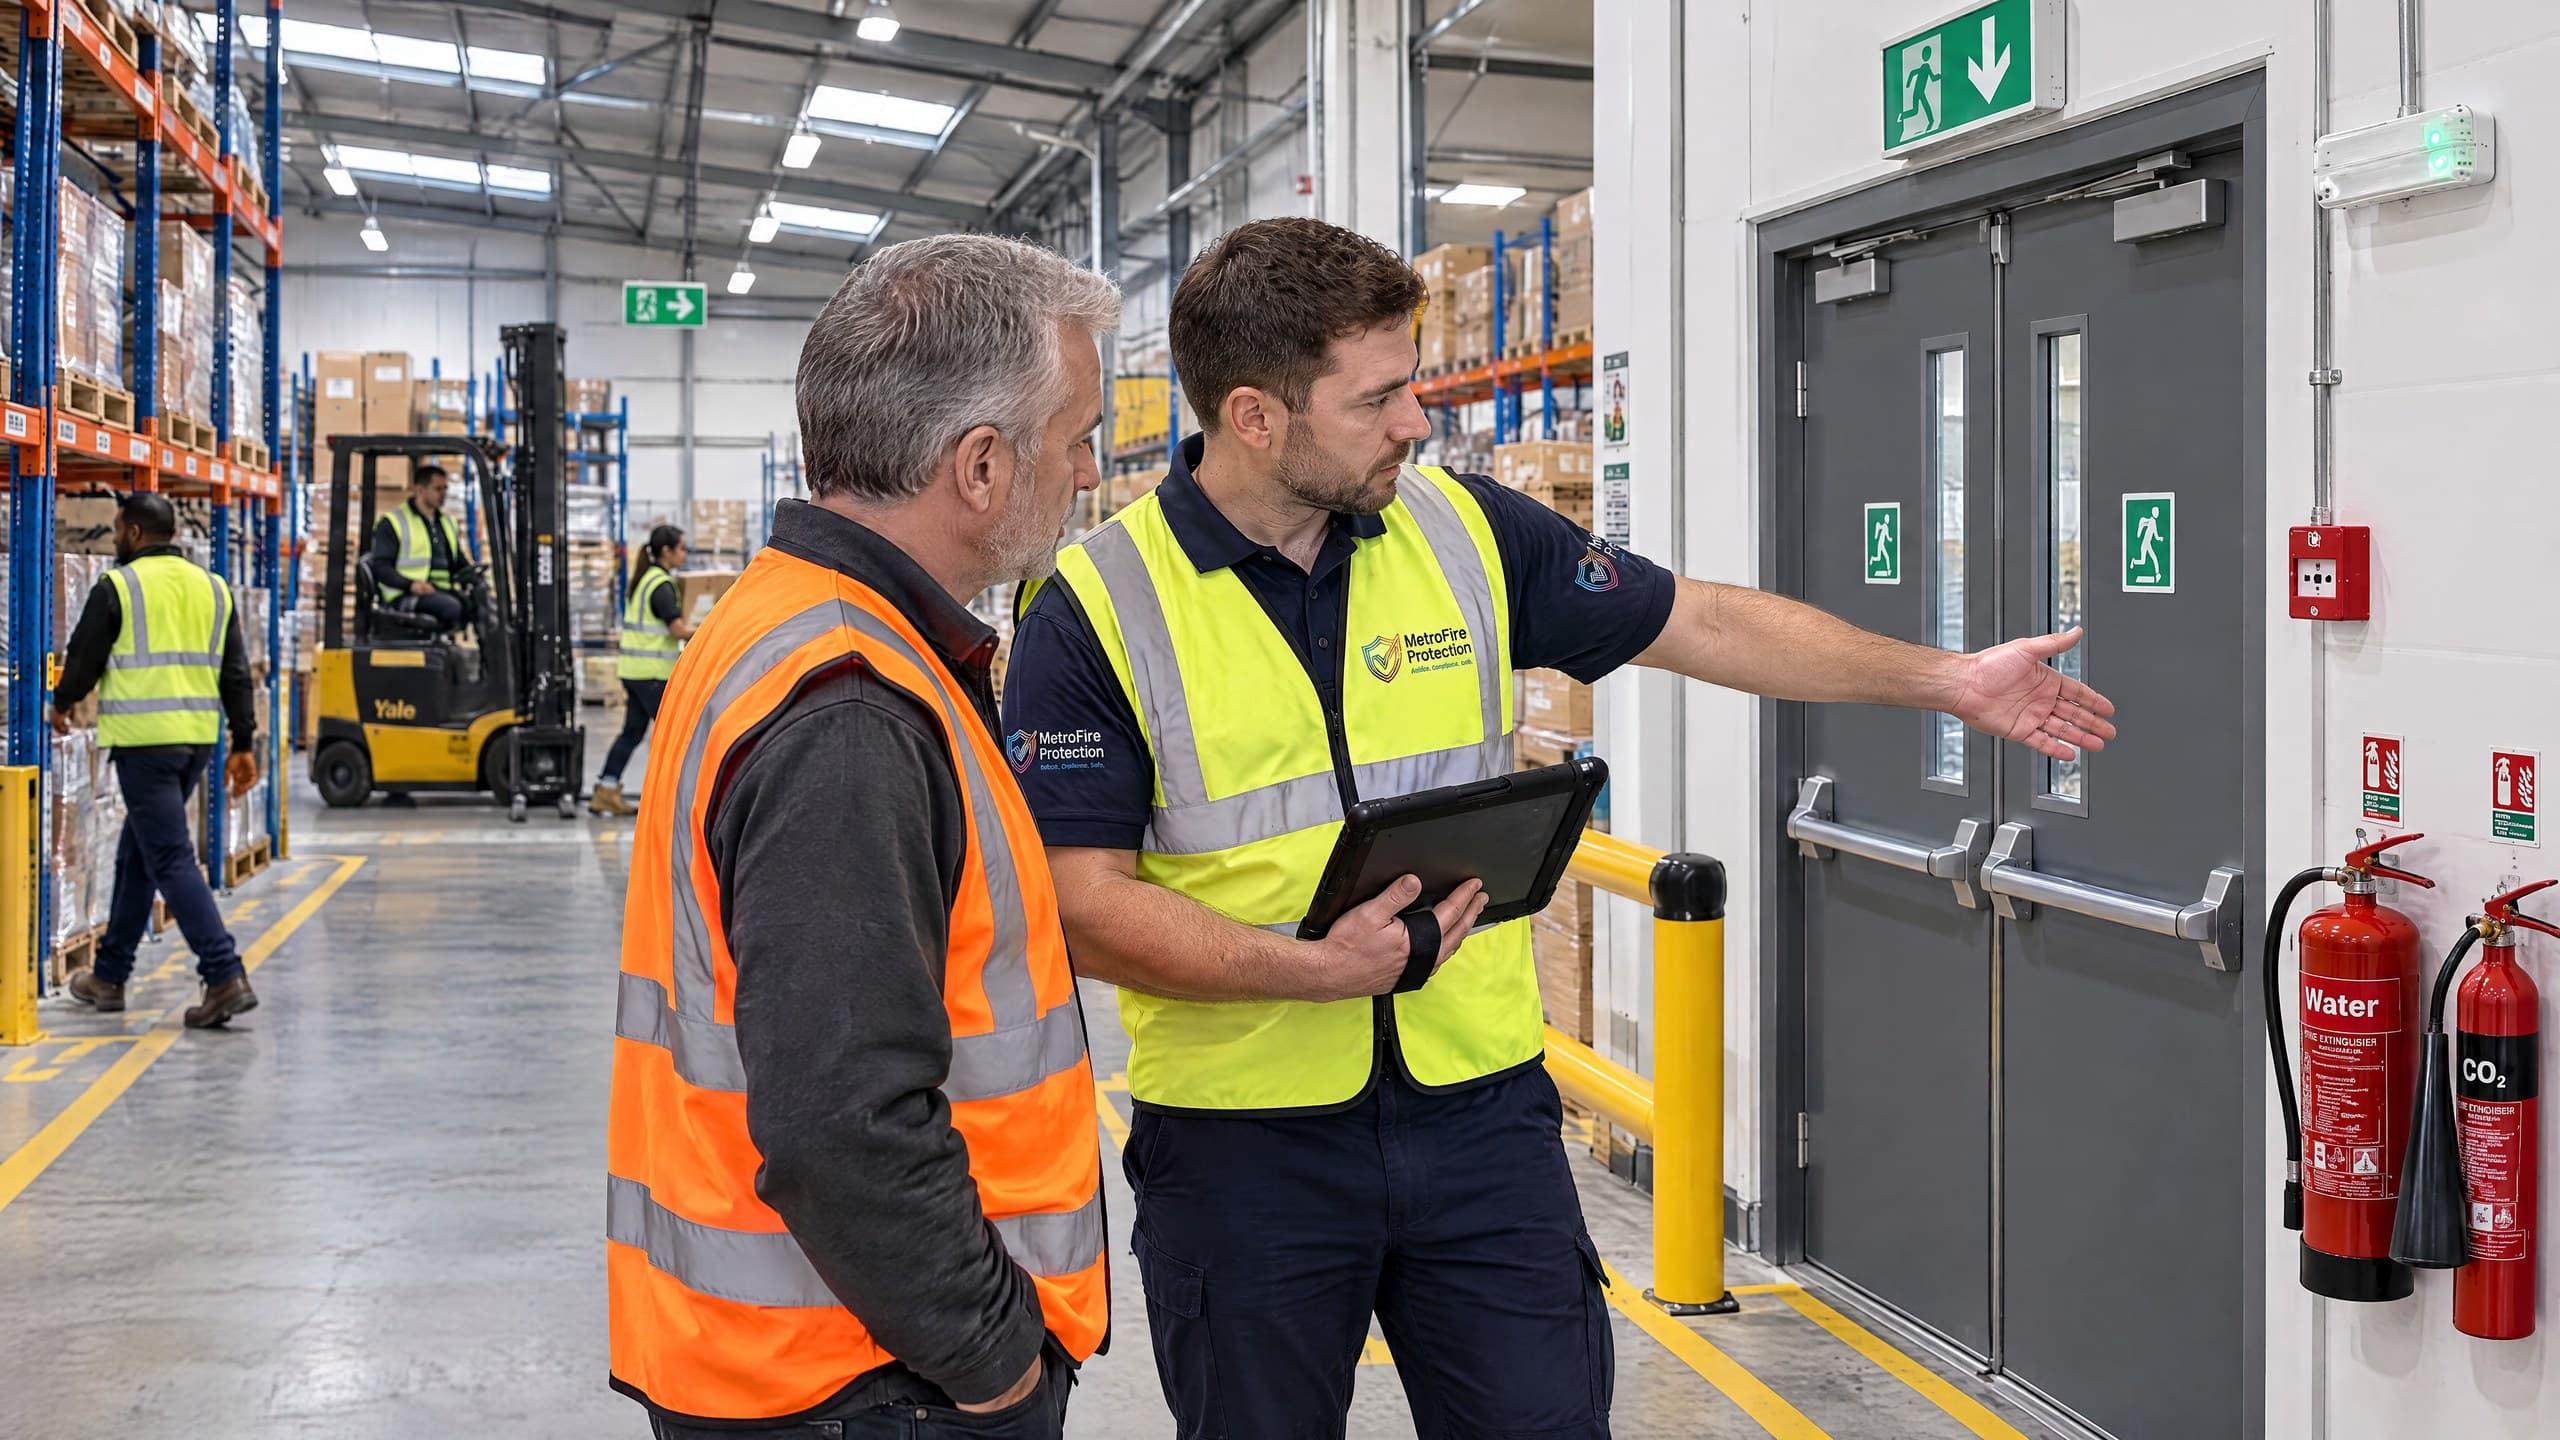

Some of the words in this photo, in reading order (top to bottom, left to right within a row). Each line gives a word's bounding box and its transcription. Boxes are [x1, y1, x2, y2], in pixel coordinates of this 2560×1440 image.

[1404, 628, 1467, 648] MetroFire
[1407, 643, 1472, 664] Protection
[374, 699, 416, 720] Yale
[1039, 729, 1102, 745] MetroFire
[1040, 745, 1105, 760] Protection
[2305, 986, 2379, 1018] Water
